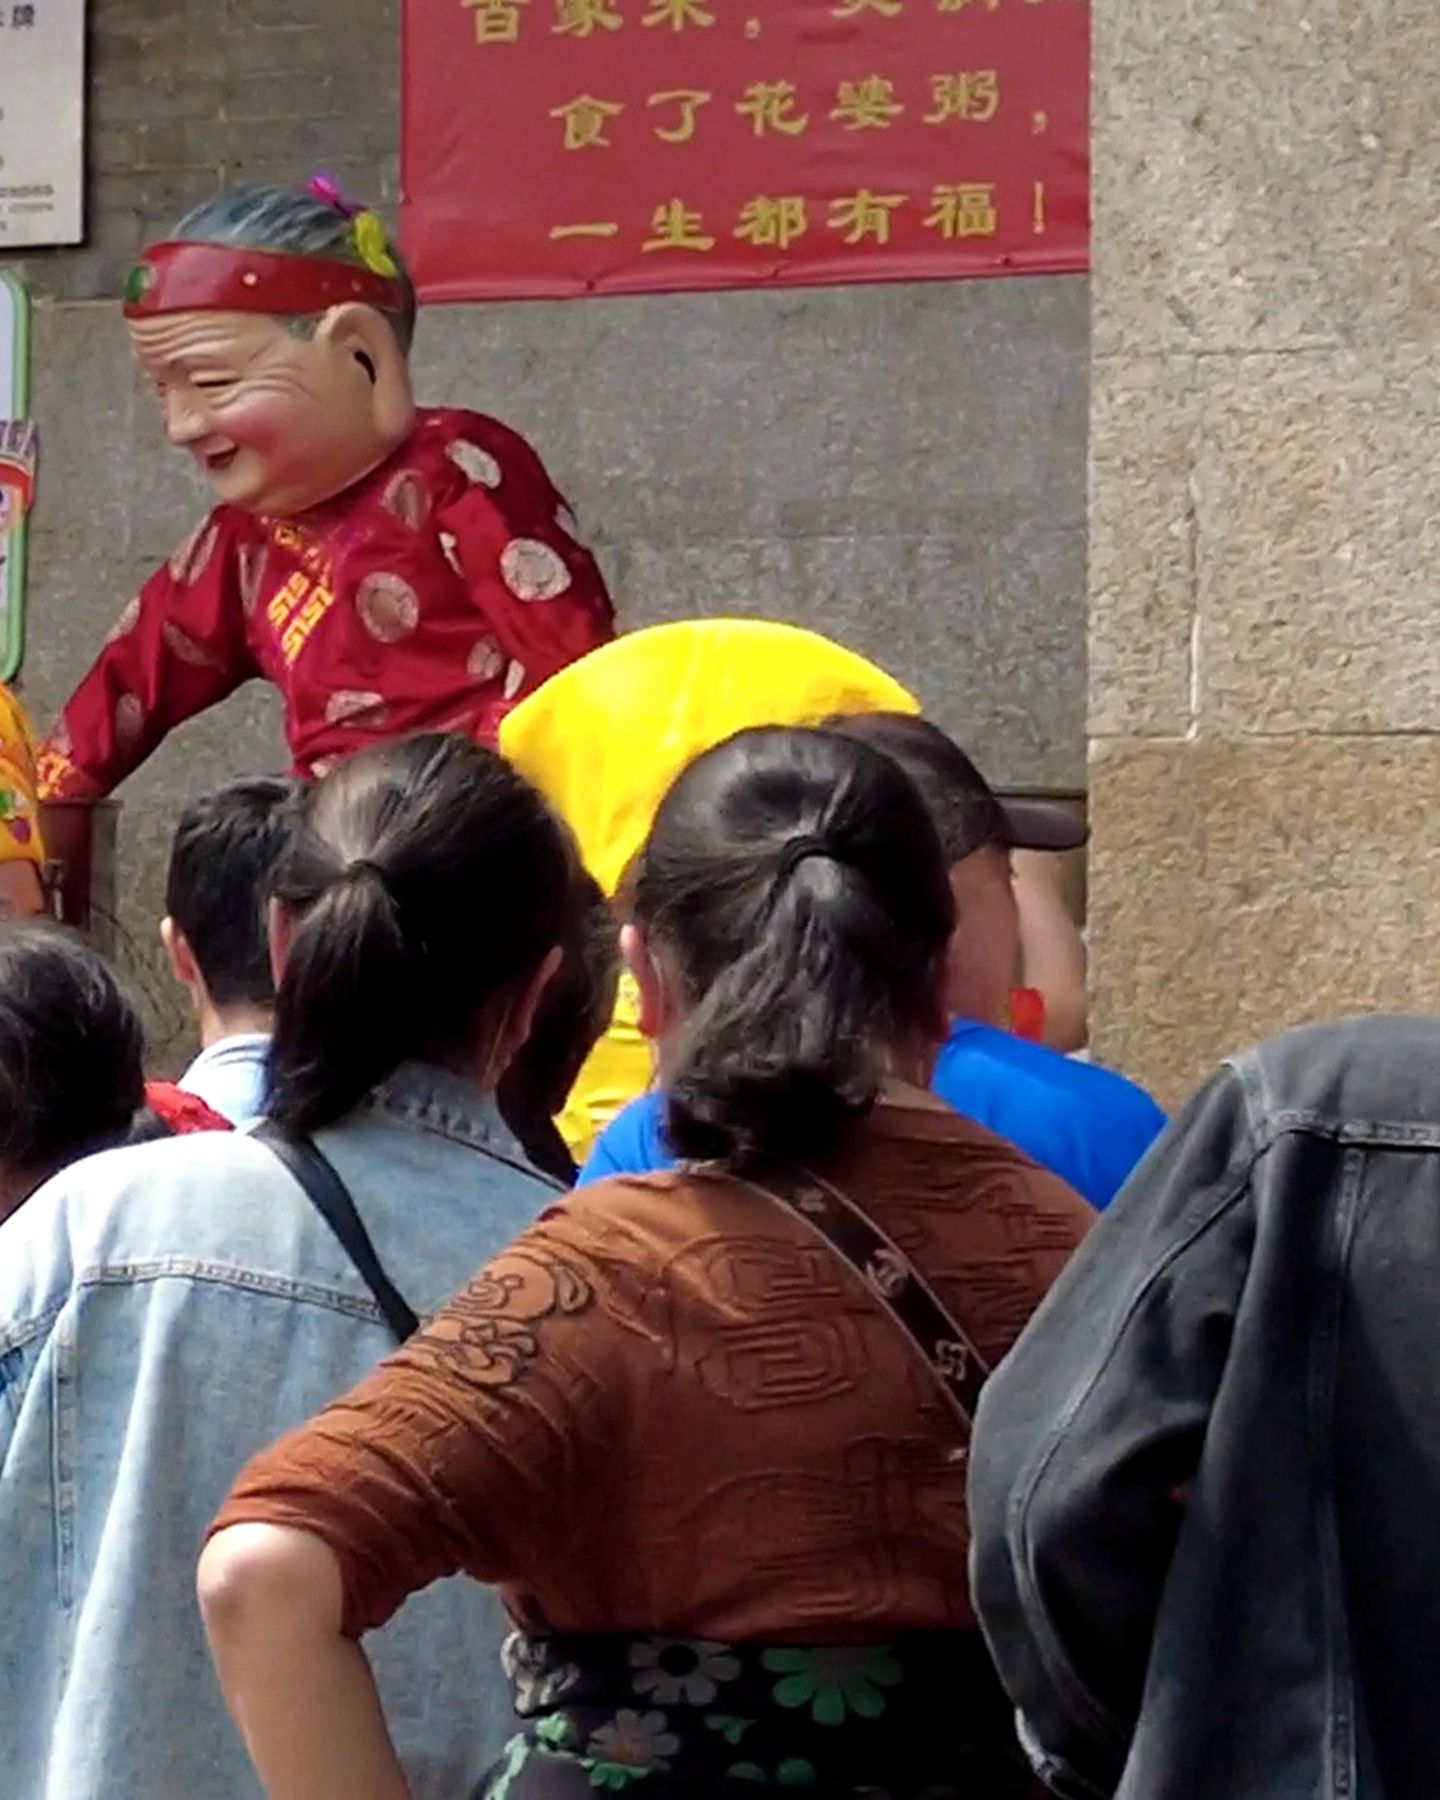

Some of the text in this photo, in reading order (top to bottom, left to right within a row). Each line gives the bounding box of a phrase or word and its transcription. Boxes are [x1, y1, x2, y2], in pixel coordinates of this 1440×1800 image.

[548, 68, 1049, 150] 食了花婆粥，
[548, 181, 1046, 254] 一生都有福！
